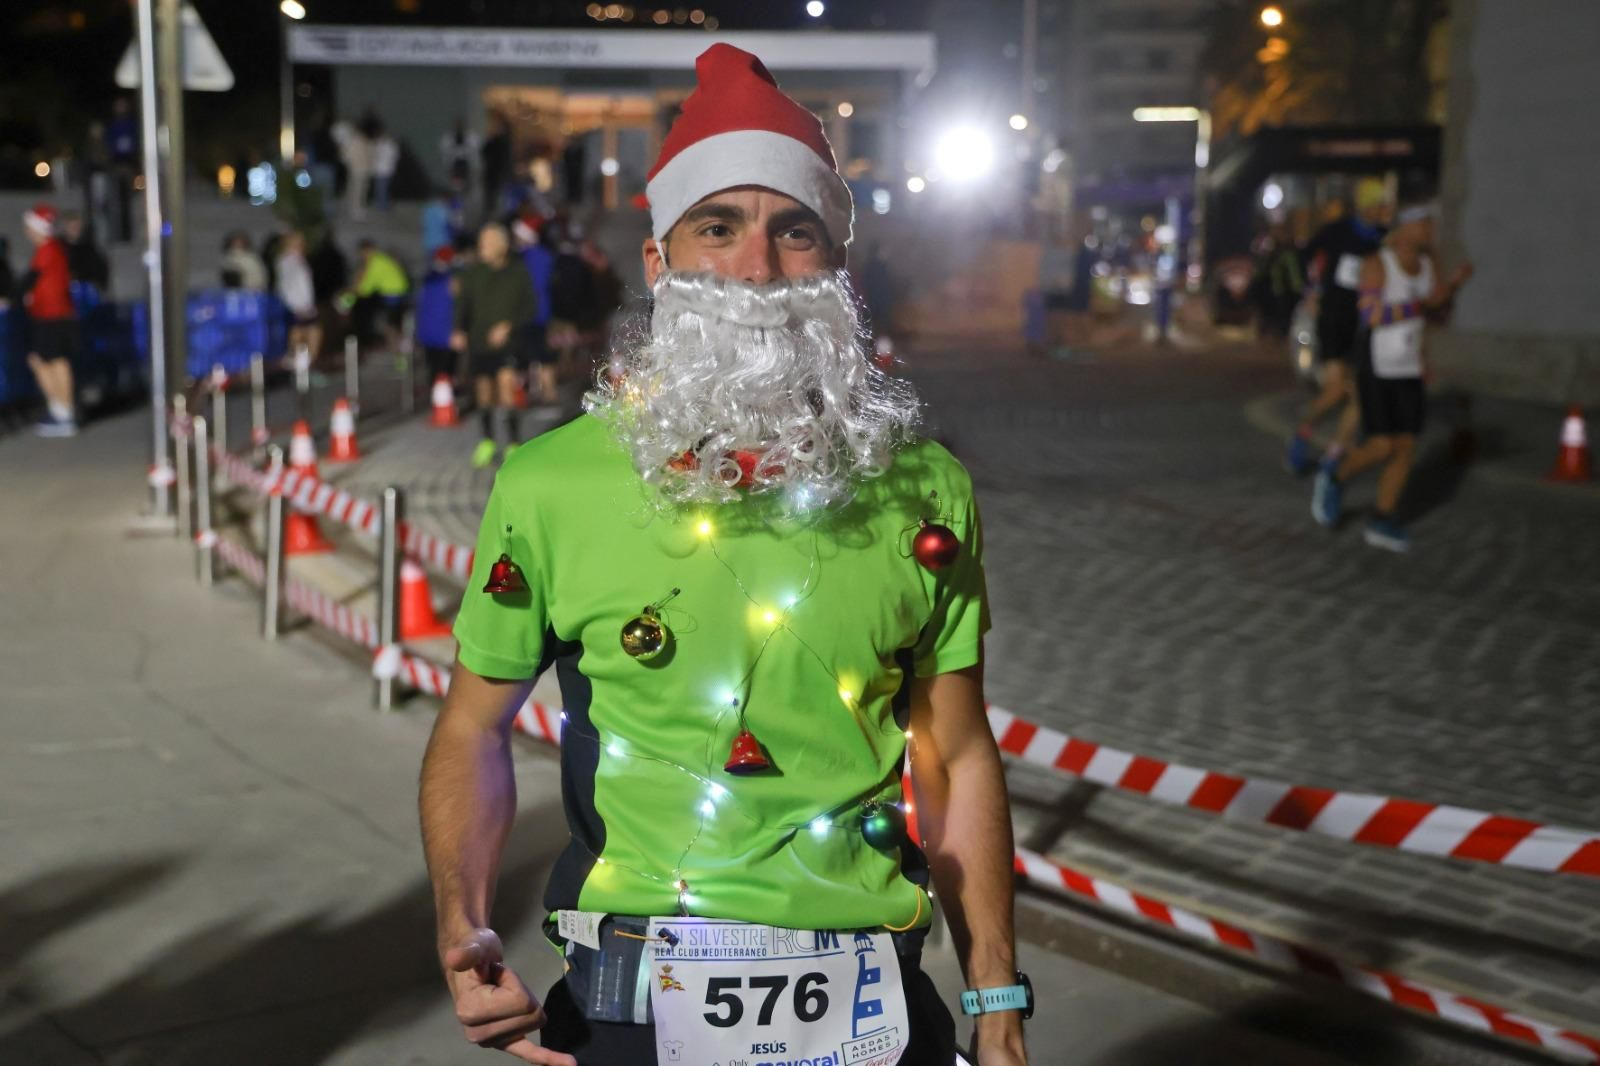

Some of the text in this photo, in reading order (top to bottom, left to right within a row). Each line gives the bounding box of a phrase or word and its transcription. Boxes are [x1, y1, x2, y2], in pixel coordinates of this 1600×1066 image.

[689, 927, 769, 947] SILVESTRE
[773, 926, 840, 955] RCM
[655, 947, 677, 957] REAL
[679, 947, 699, 957] CLUB
[703, 971, 830, 1028] 576
[750, 1040, 788, 1055] JESÚS
[852, 1034, 891, 1052] AEDAS
[852, 1041, 891, 1059] HOMES
